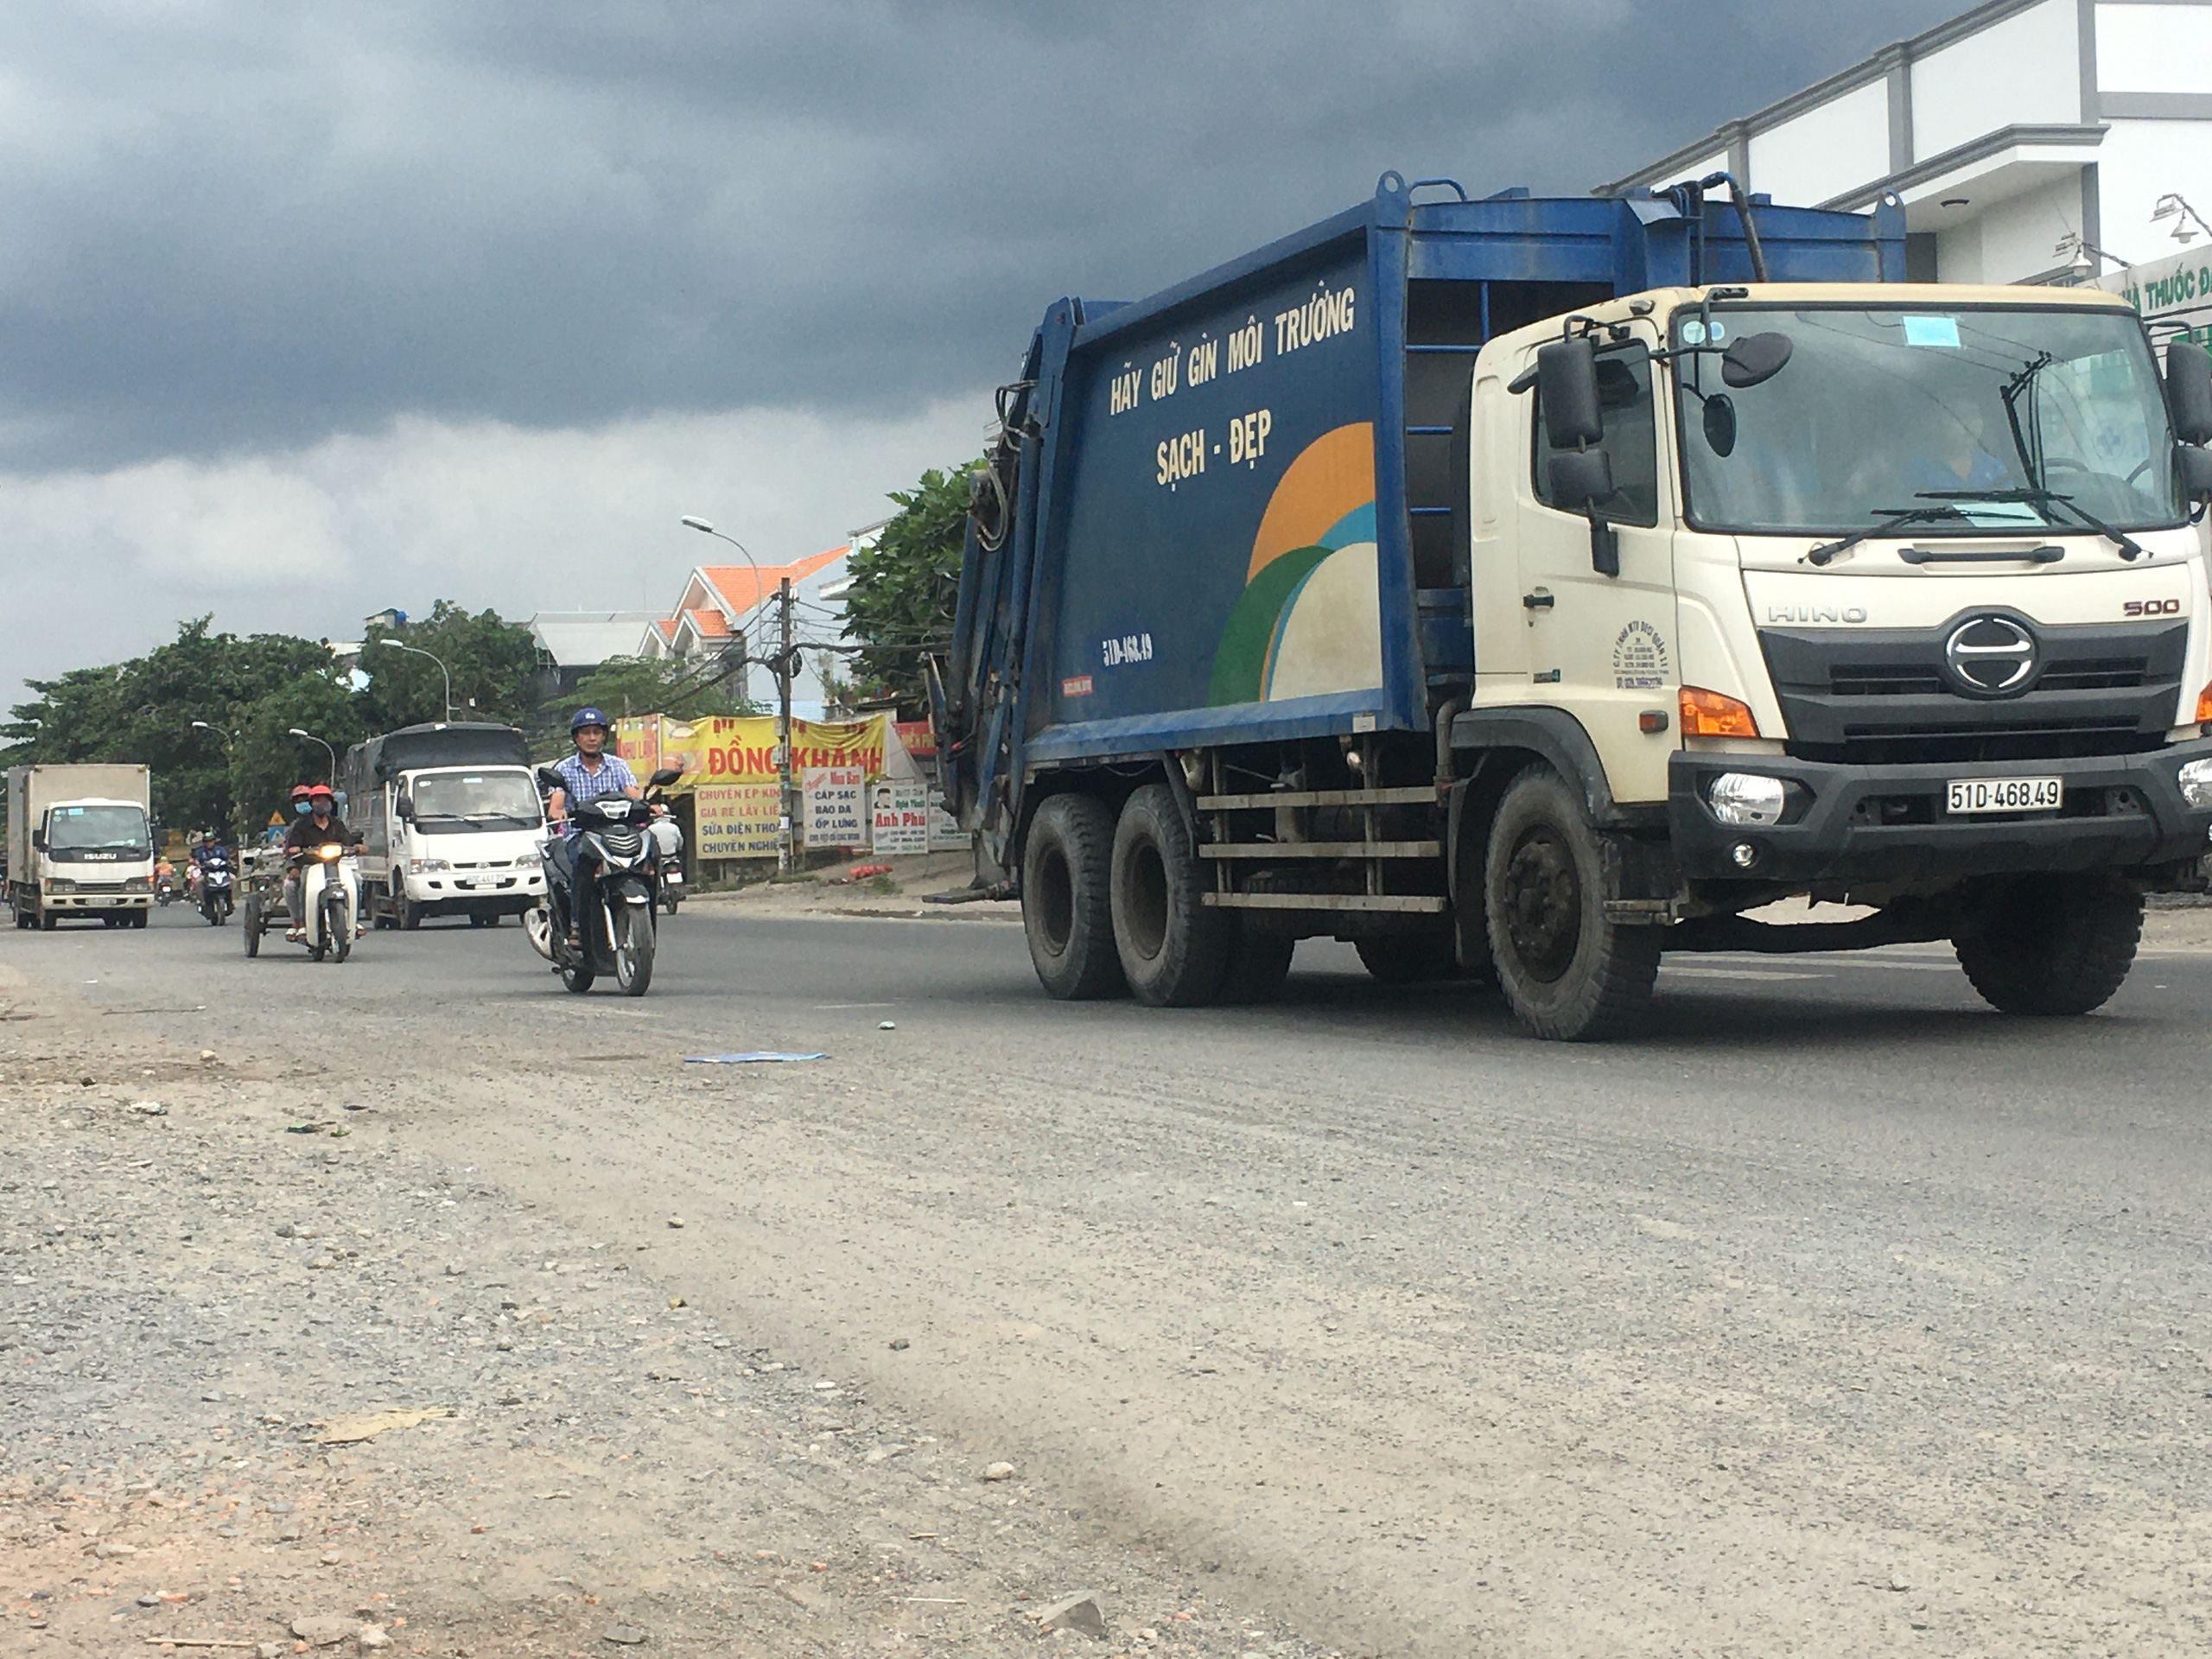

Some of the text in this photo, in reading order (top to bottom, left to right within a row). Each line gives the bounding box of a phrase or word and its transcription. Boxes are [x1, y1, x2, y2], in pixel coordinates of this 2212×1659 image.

[2145, 262, 2195, 310] THUỐC
[1110, 361, 1142, 416] HÃY
[1151, 340, 1180, 401] GIỮ
[1228, 315, 1263, 373] MÔI
[1274, 280, 1355, 355] TRƯỜNG
[1156, 429, 1205, 492] SẠCH
[1230, 409, 1272, 469] ĐẸP
[1769, 606, 1867, 623] HINO
[2122, 599, 2180, 618] 500
[709, 735, 883, 775] ĐỒNG KHÁNH
[1950, 780, 2058, 809] 51D-468.49
[815, 804, 851, 814] BAO DA
[754, 823, 779, 834] THO
[875, 813, 899, 827] Anh
[748, 837, 779, 852] NGHIỆ
